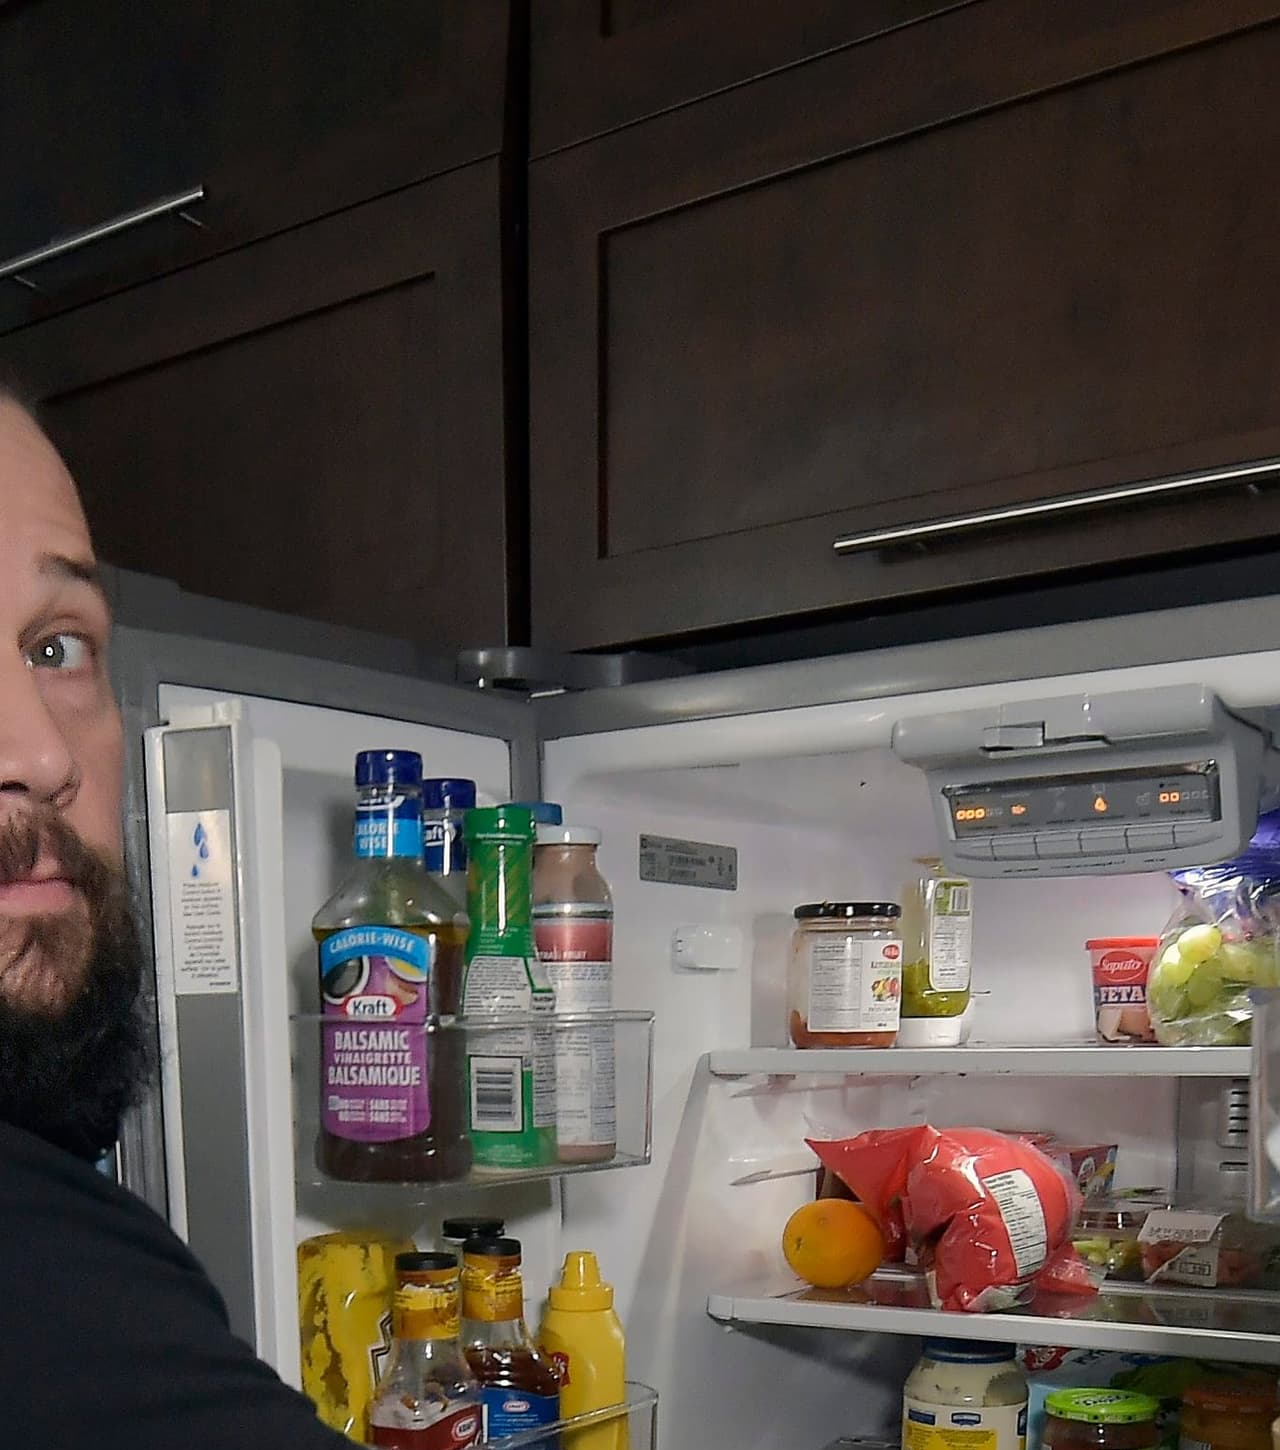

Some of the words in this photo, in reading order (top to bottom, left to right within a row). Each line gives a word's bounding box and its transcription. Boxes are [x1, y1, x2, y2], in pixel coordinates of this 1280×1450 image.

[1101, 958, 1142, 975] Saputo
[1100, 985, 1146, 1003] FETA
[353, 1000, 388, 1015] Kraft
[334, 1030, 410, 1051] BALSAMIC
[333, 1051, 413, 1065] VINAIGRETTE
[327, 1065, 421, 1086] BALSAMIQUE
